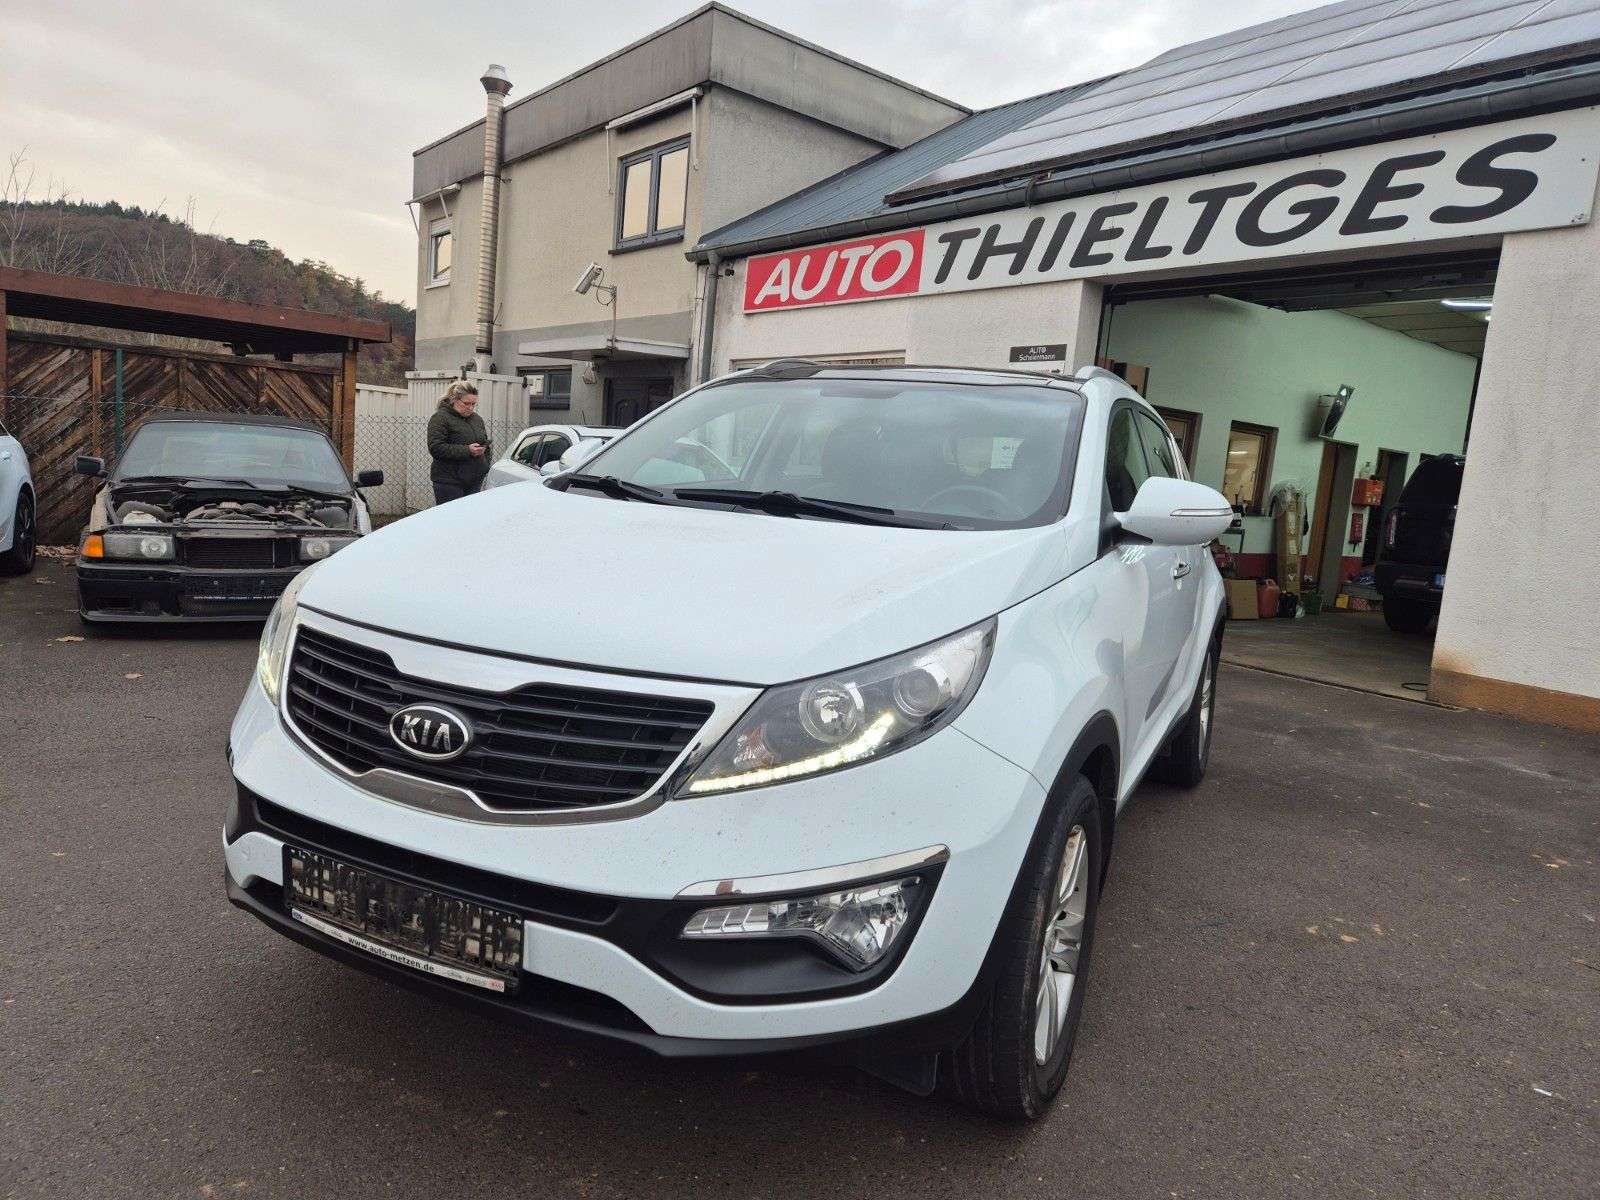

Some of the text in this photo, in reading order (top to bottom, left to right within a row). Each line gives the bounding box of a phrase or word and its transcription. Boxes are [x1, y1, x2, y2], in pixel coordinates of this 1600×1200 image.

[754, 133, 1557, 305] AUTO THIELTGES
[401, 715, 451, 752] KIA
[348, 936, 435, 973] www.auto-metzen.de
